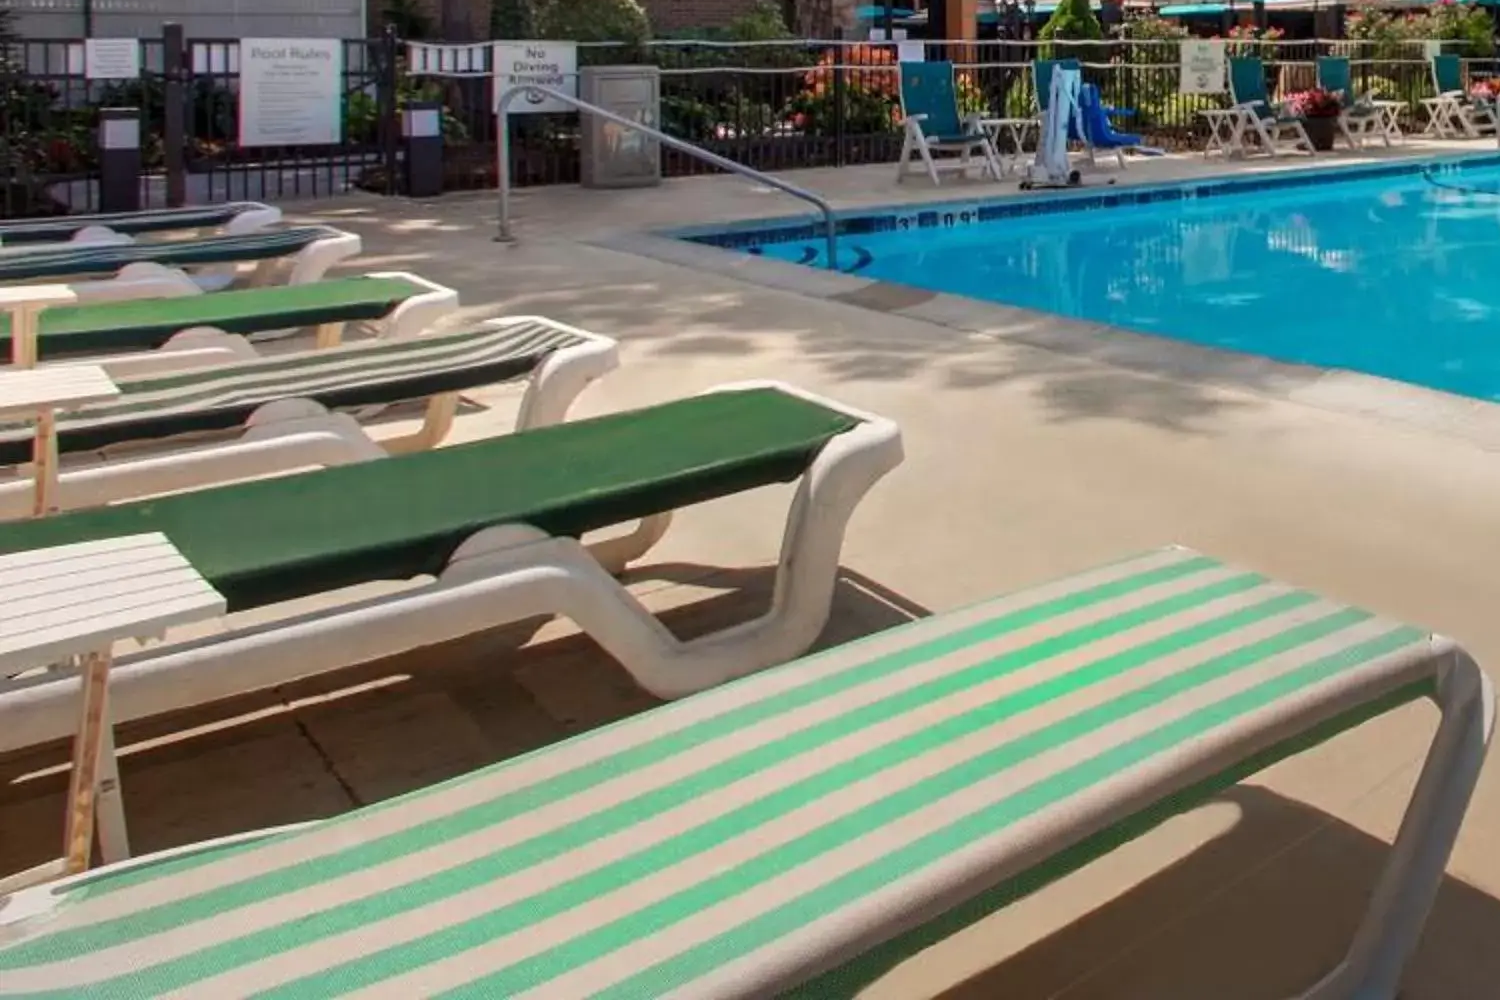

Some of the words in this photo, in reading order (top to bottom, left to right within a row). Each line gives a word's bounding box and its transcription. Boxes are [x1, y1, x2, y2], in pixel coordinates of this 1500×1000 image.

[250, 46, 286, 59] Pool
[525, 46, 546, 58] No
[513, 61, 559, 73] Diving
